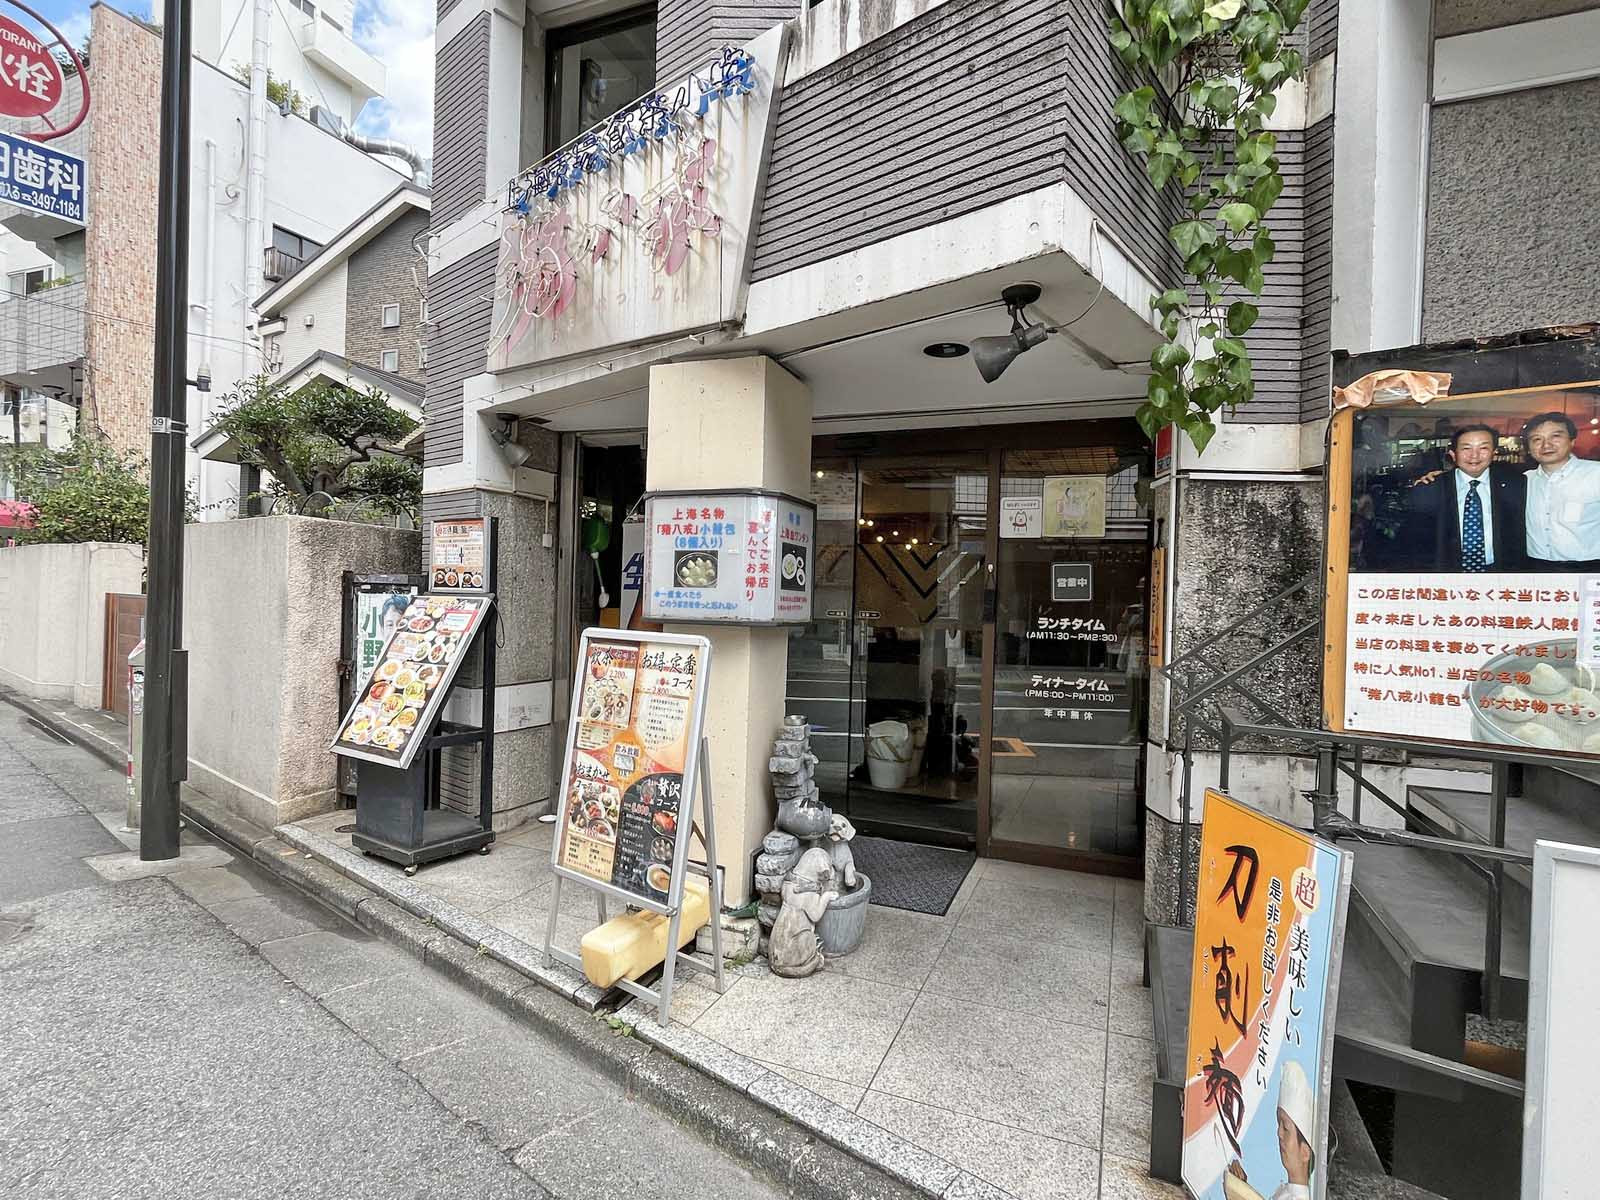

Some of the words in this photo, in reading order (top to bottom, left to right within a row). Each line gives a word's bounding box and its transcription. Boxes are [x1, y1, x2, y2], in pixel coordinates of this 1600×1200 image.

[0, 28, 43, 55] DRANT
[31, 190, 81, 219] 3497-1184
[671, 506, 726, 521] 上海名物
[674, 535, 723, 549] (8個入り)
[744, 520, 759, 602] 喜んでお帰り
[1056, 577, 1088, 588] 営業中
[1037, 616, 1106, 631] ランチタイム
[671, 677, 694, 690] コース
[1044, 708, 1094, 721] 年中無休
[656, 777, 681, 799] 贅沢
[656, 798, 679, 812] コース
[1294, 871, 1316, 909] 超
[1255, 877, 1282, 1091] 是非お試しください
[1284, 925, 1311, 1047] 美味しい
